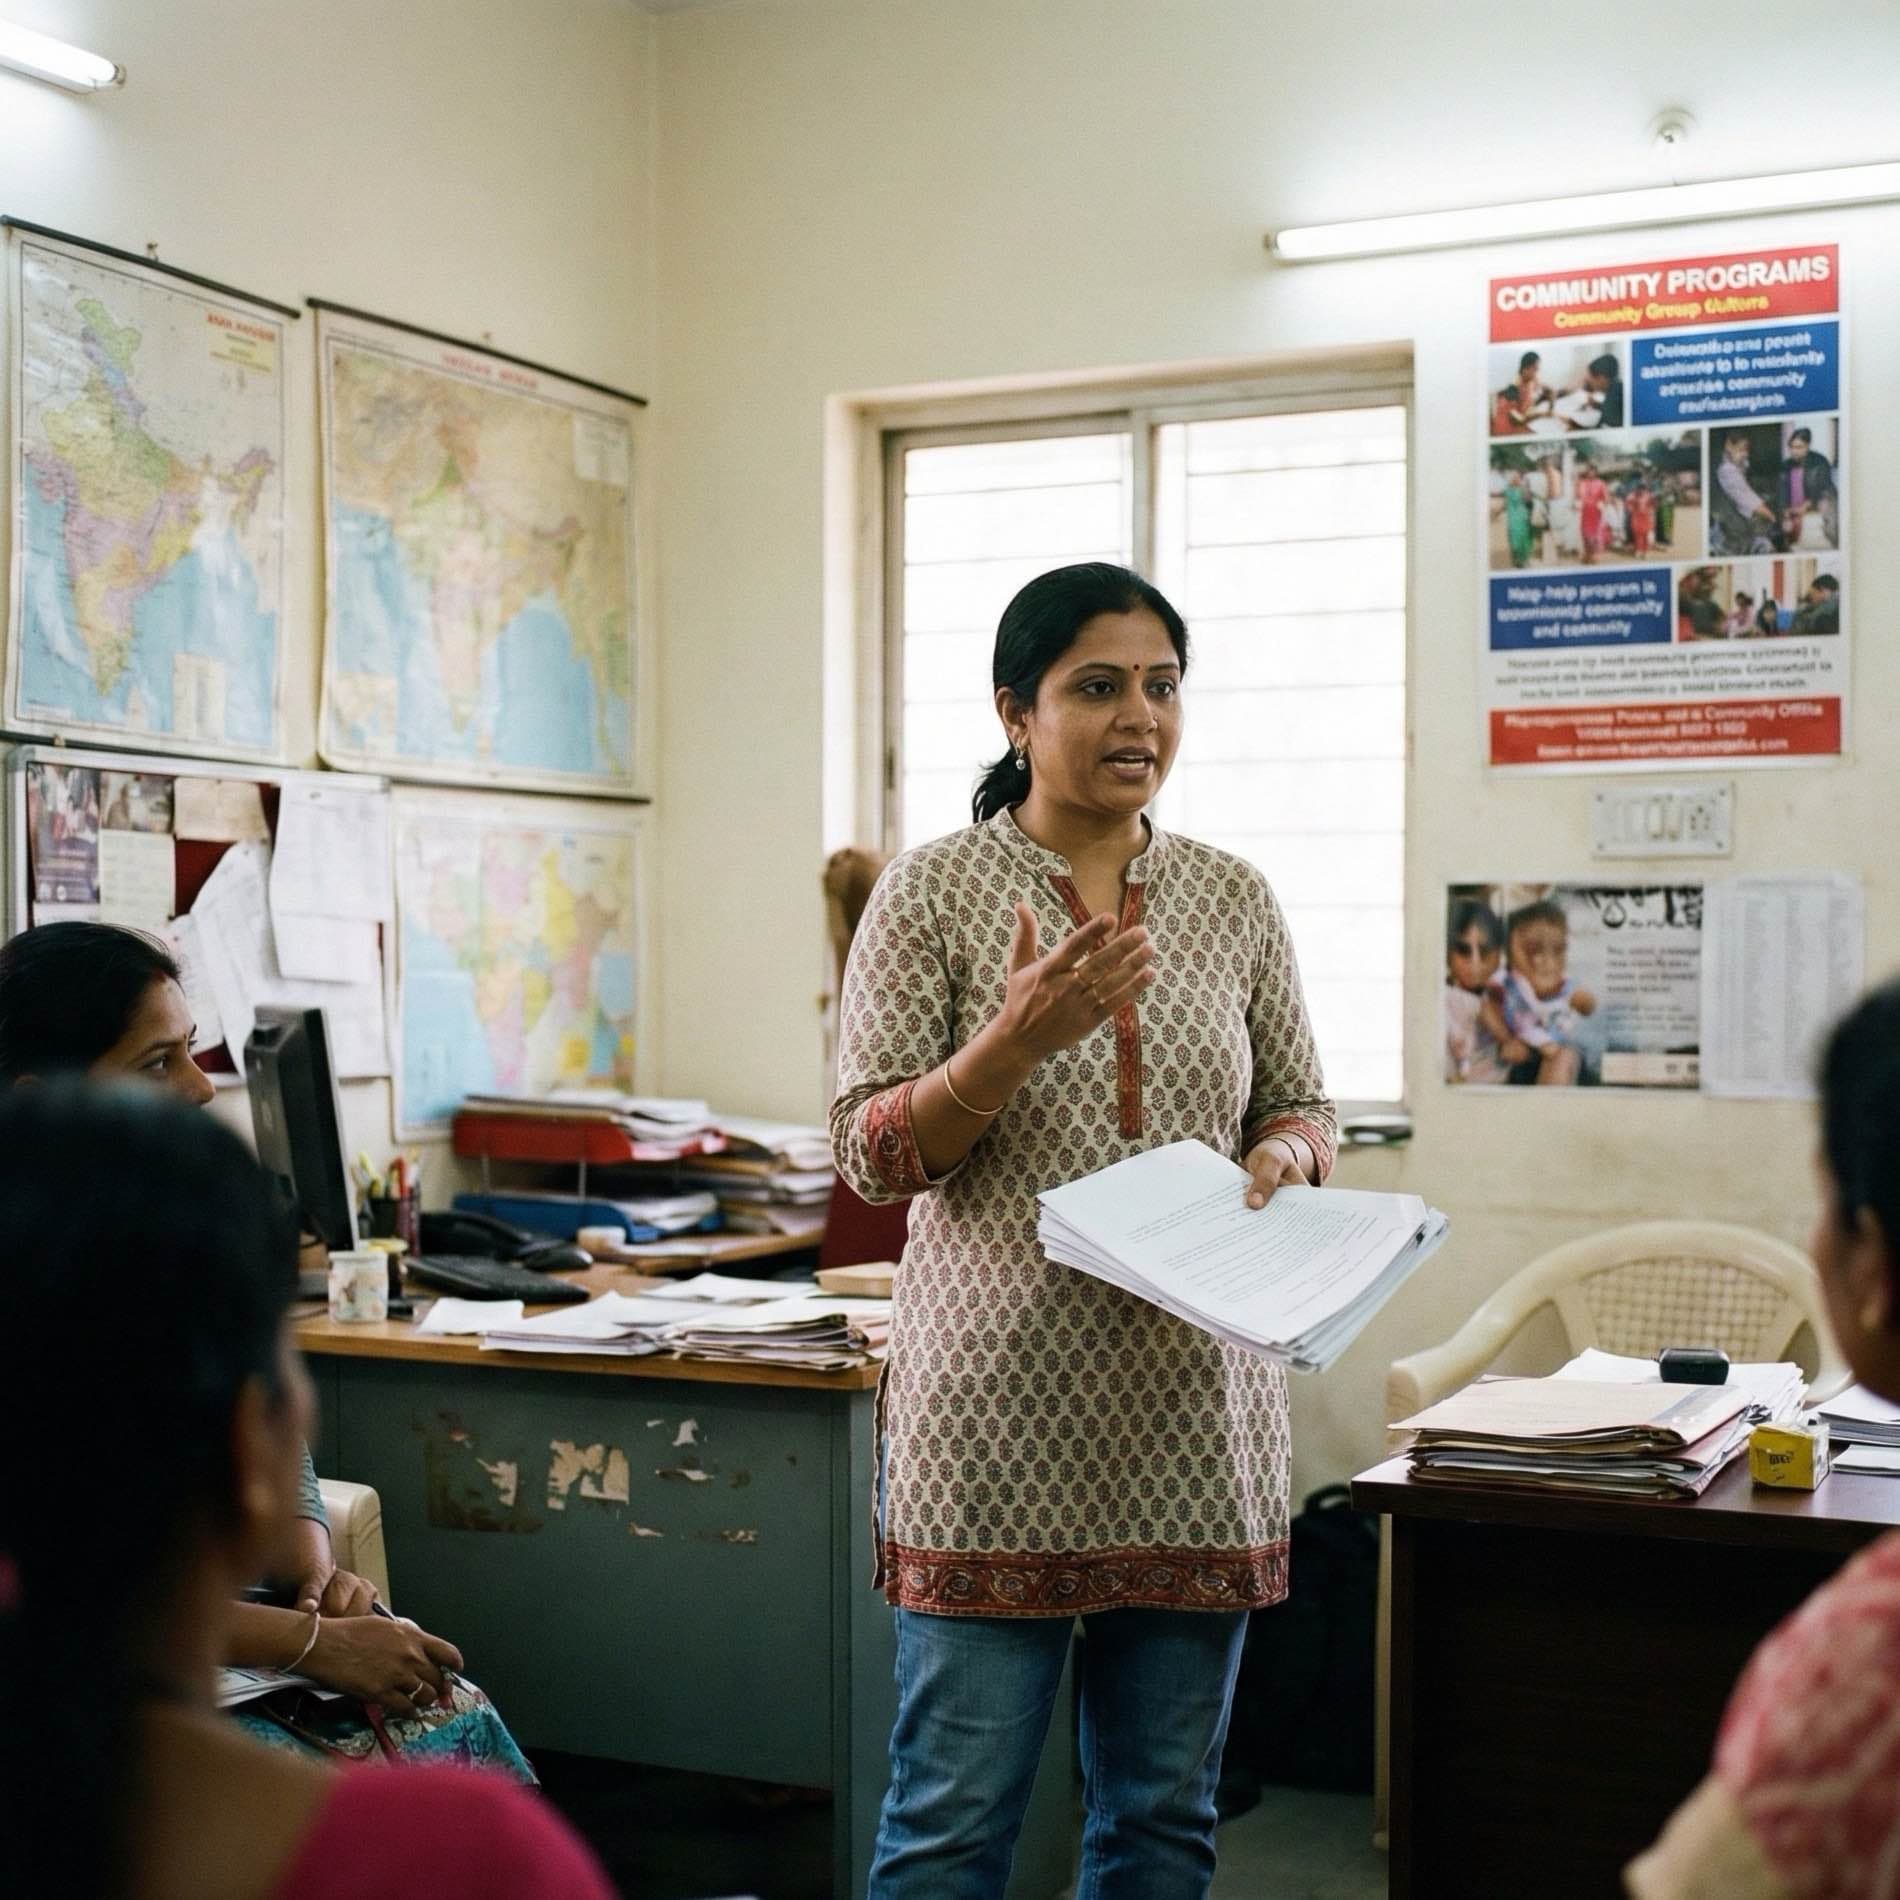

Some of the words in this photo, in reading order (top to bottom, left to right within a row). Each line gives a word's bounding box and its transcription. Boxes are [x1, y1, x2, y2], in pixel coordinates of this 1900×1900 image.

[1498, 273, 1661, 311] COMMUNITY
[1668, 256, 1829, 294] PROGRAMS
[1554, 306, 1643, 329] Community
